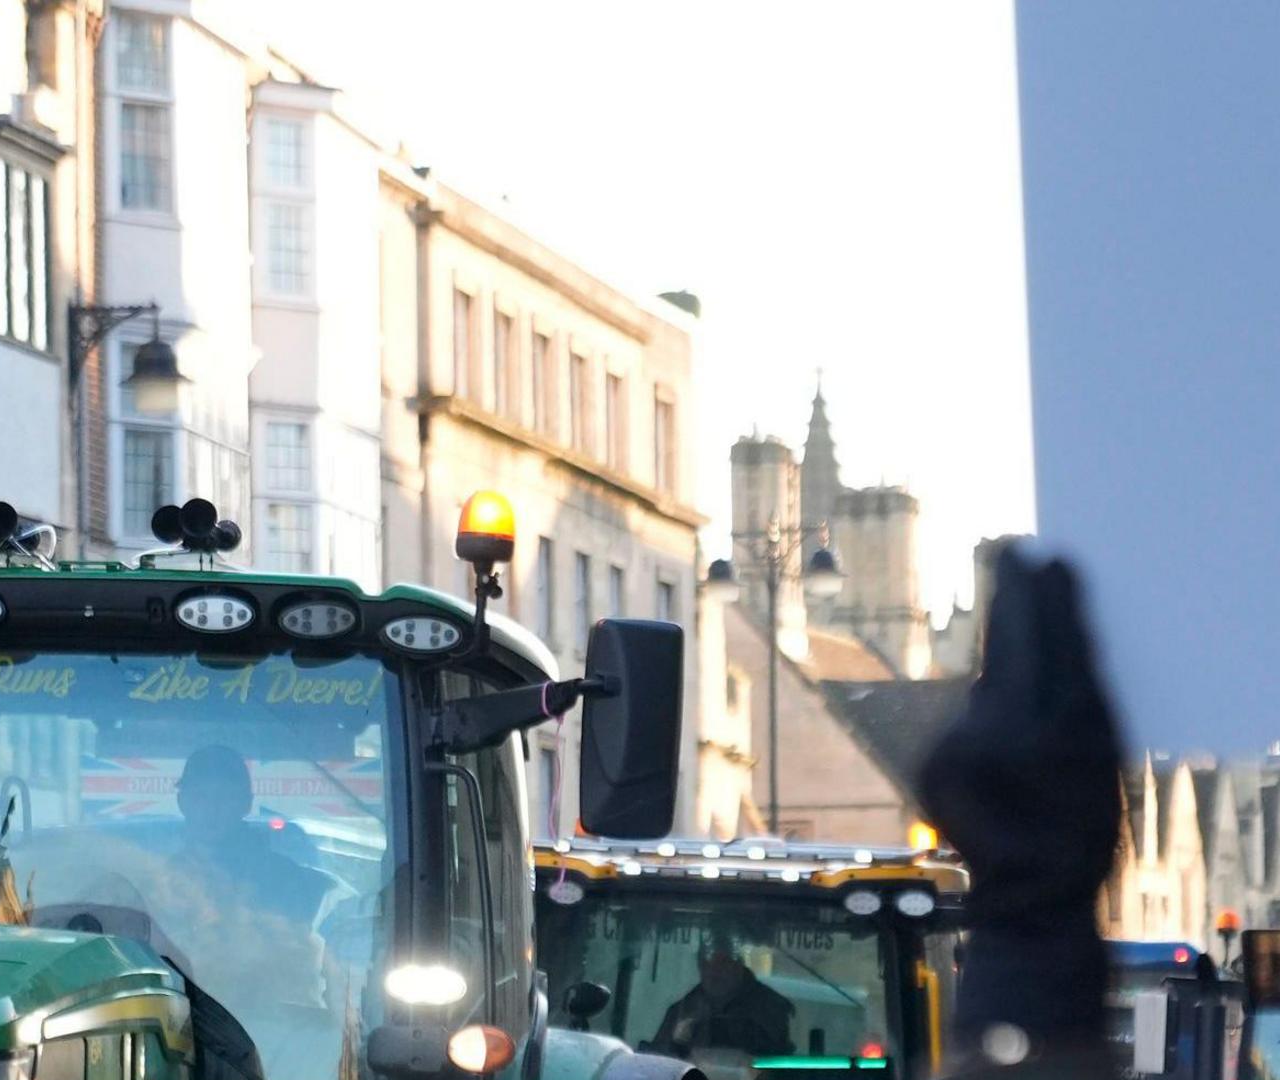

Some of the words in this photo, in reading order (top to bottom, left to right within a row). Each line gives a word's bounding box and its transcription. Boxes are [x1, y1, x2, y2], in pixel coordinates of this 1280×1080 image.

[129, 659, 209, 703] Like
[222, 662, 254, 703] A
[266, 660, 385, 705] Deere!
